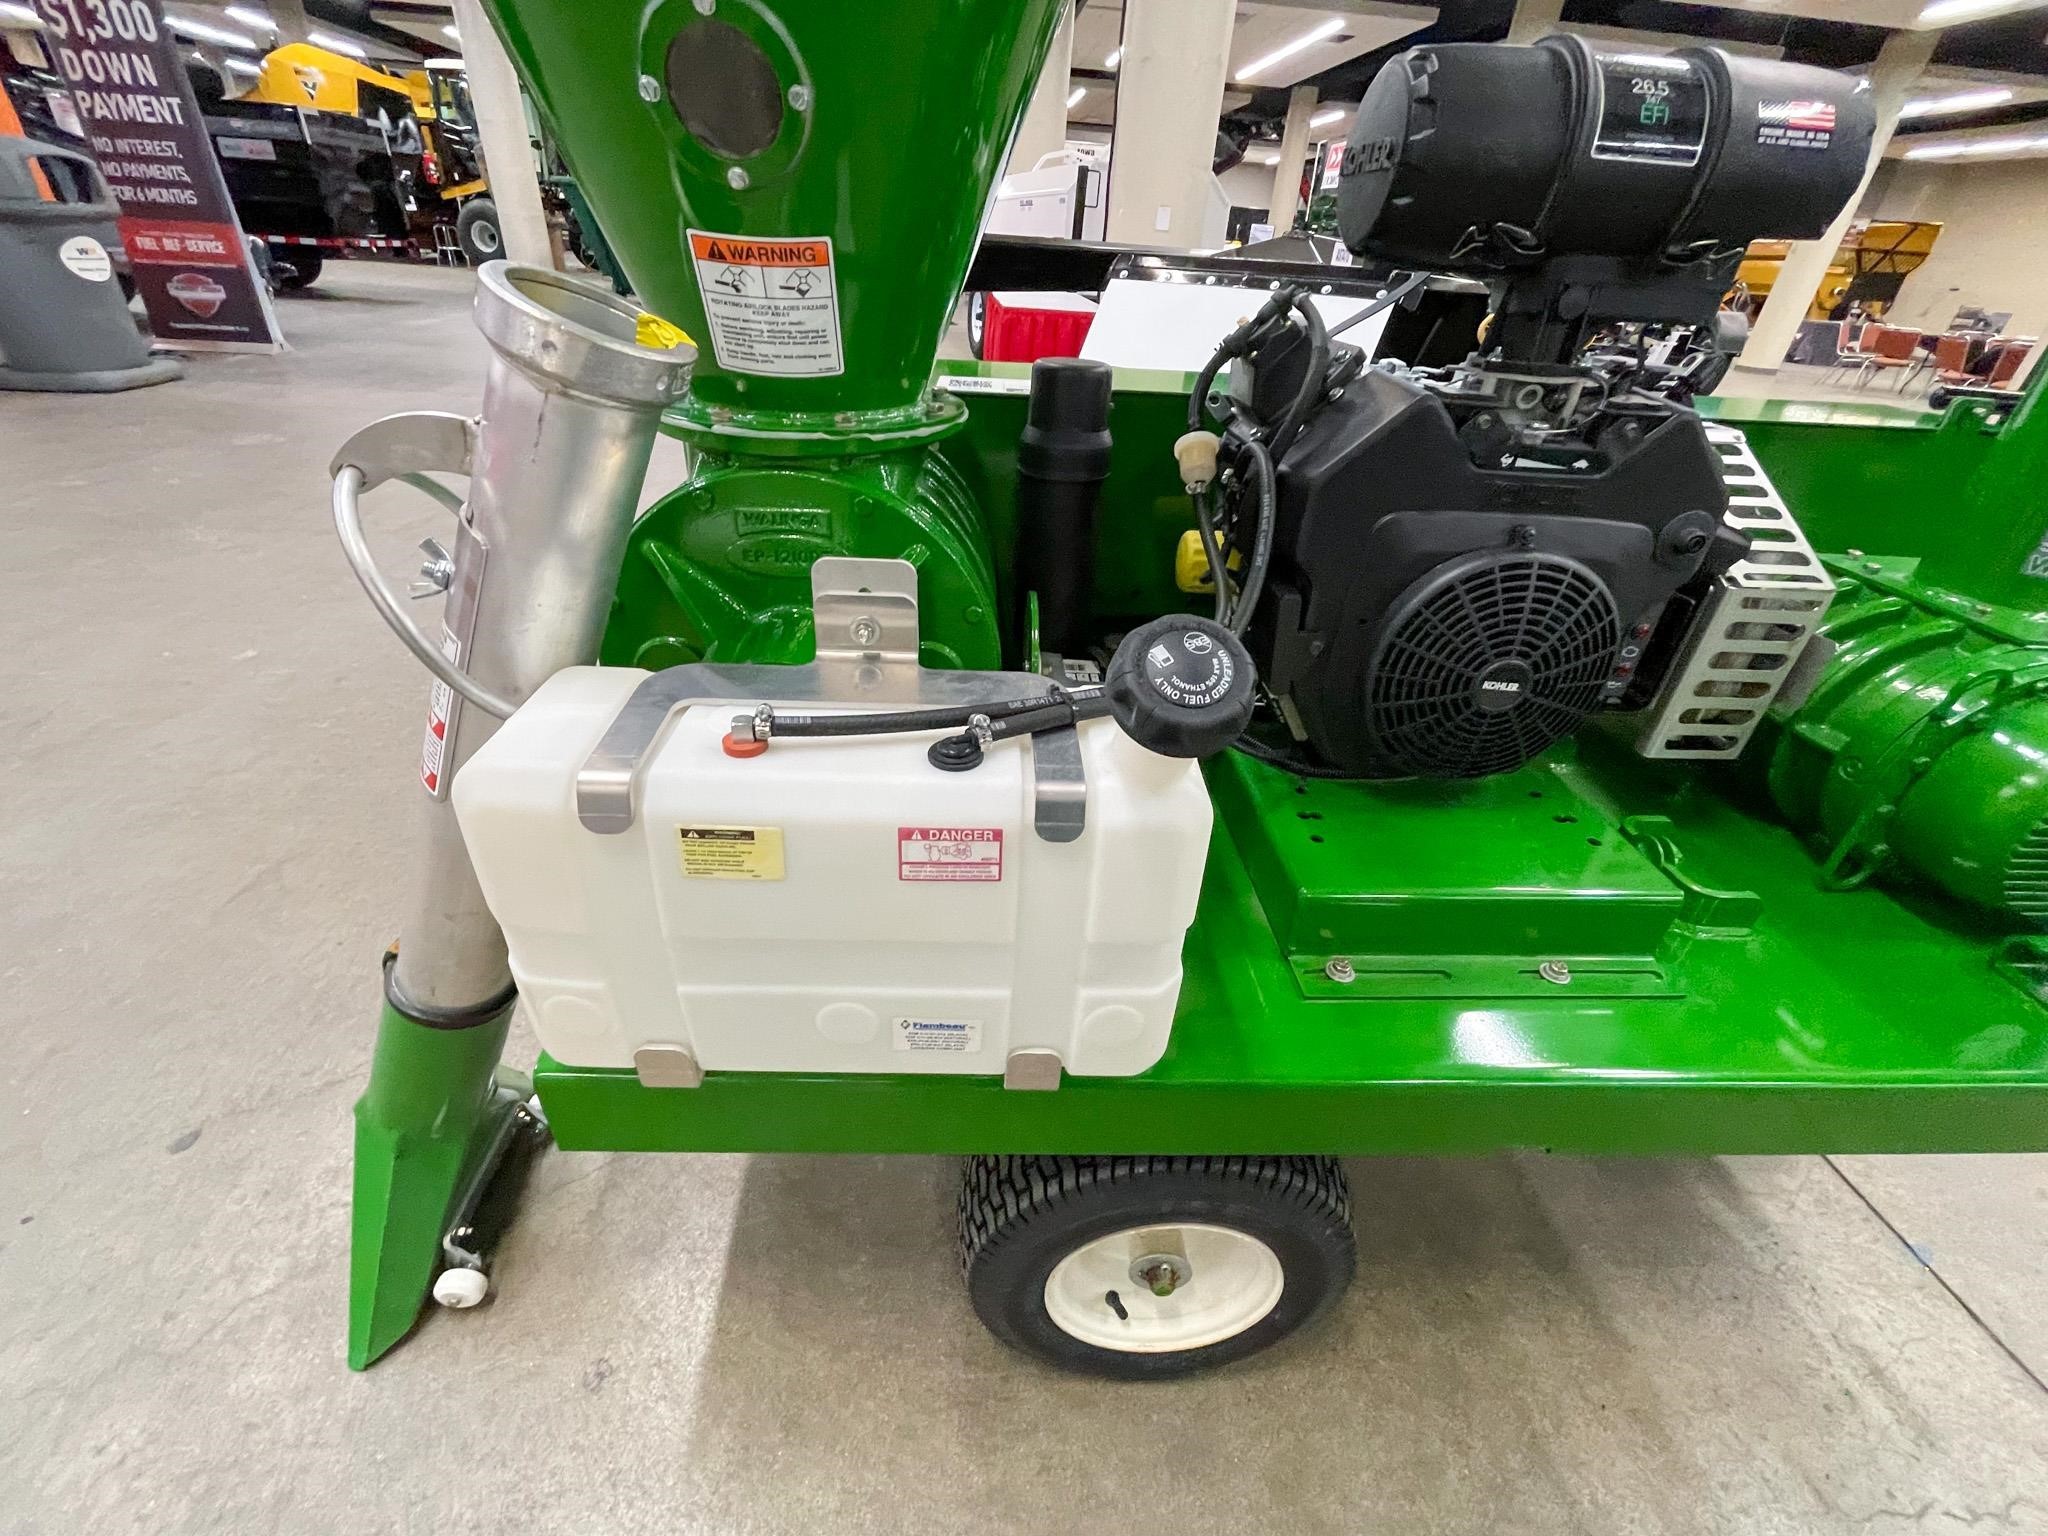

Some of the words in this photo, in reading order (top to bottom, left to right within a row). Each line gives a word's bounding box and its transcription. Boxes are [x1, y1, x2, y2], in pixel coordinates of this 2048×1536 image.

[42, 0, 158, 45] $1,300
[59, 47, 158, 87] DOWN
[74, 90, 184, 125] PAYMENT
[1640, 103, 1669, 125] EFI
[92, 137, 114, 153] NO
[115, 138, 183, 159] INTEREST.
[100, 161, 121, 177] NO
[145, 187, 198, 205] MONTHS
[726, 243, 817, 263] WARNING
[1171, 675, 1206, 691] ETHANOL
[1211, 649, 1232, 699] UNLEADED
[1154, 677, 1180, 700] ONLY
[1482, 680, 1520, 691] KOHLER
[1183, 693, 1211, 704] FUEL
[929, 829, 993, 841] DANGER
